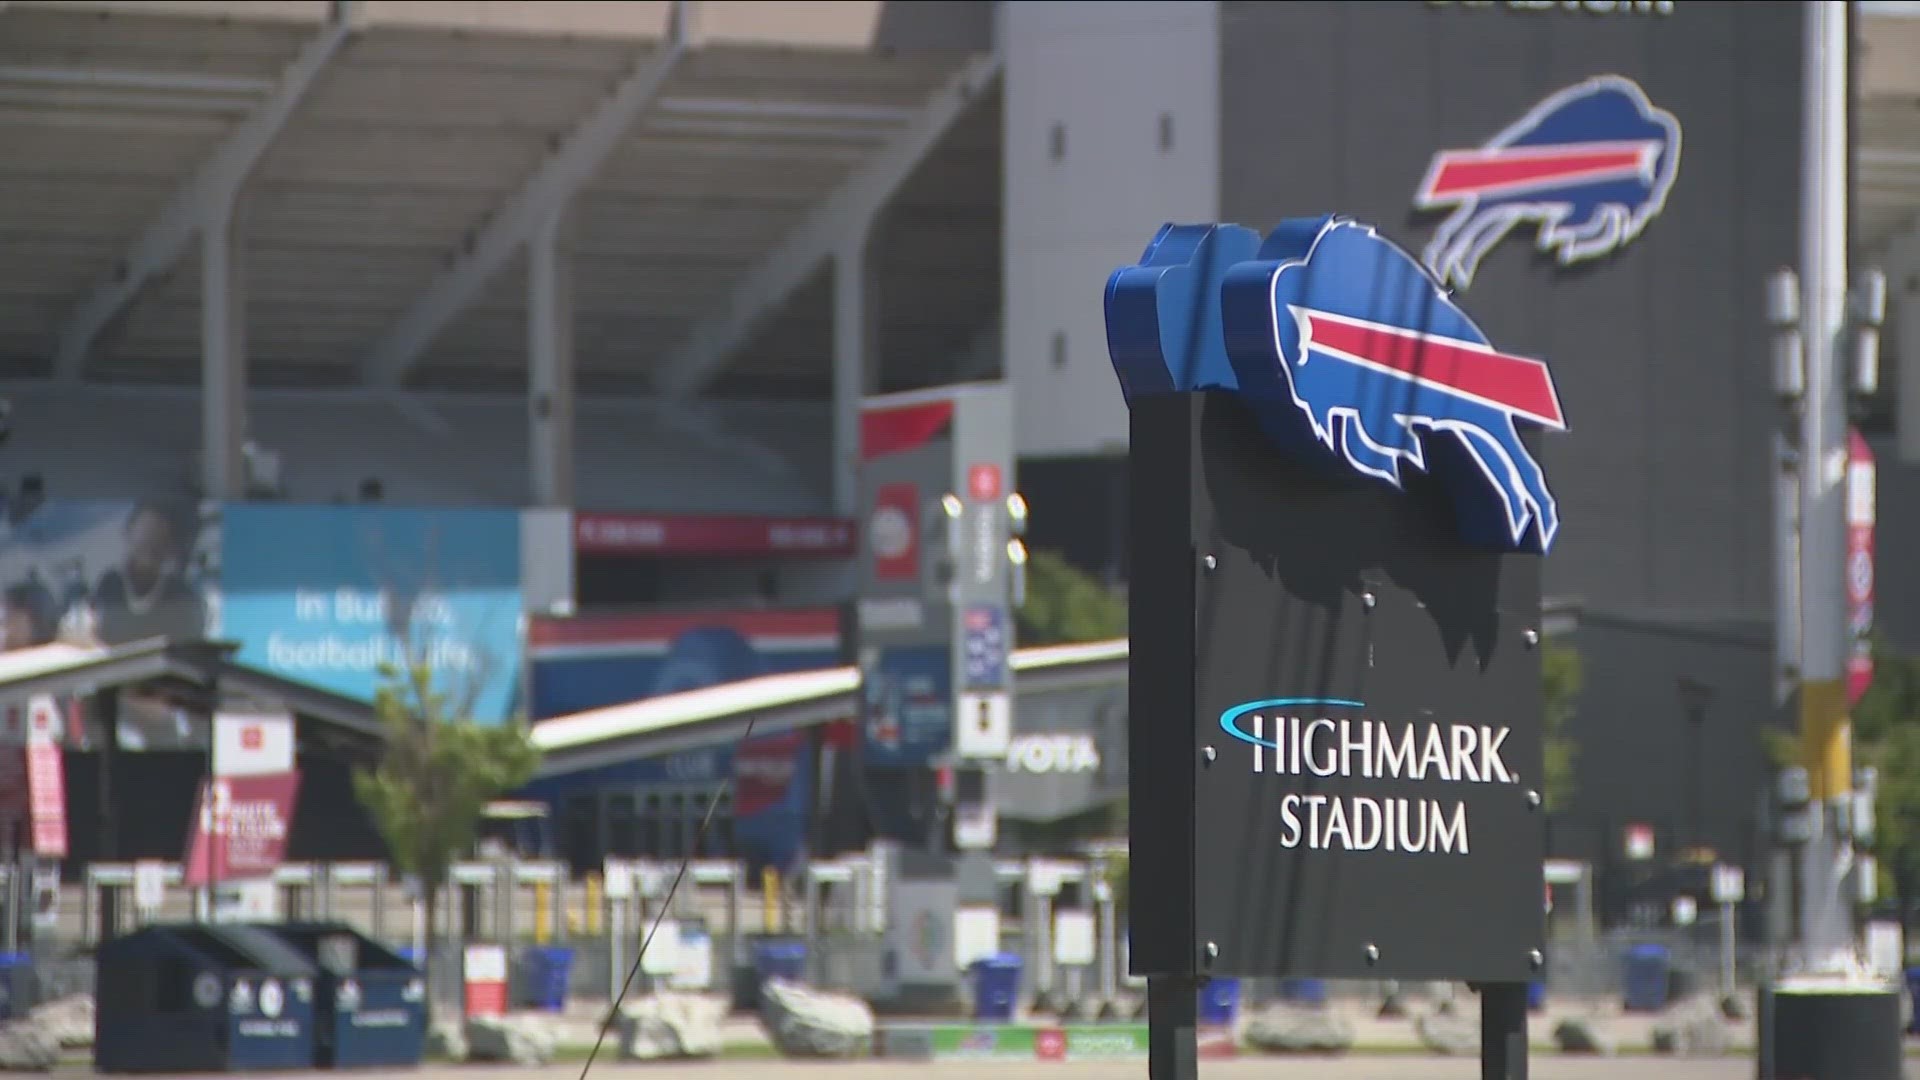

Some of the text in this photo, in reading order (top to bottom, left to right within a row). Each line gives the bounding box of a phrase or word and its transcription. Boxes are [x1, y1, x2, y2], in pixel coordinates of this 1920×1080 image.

[268, 633, 385, 669] football
[1006, 734, 1100, 773] YOTA
[1280, 794, 1470, 854] STADIUM
